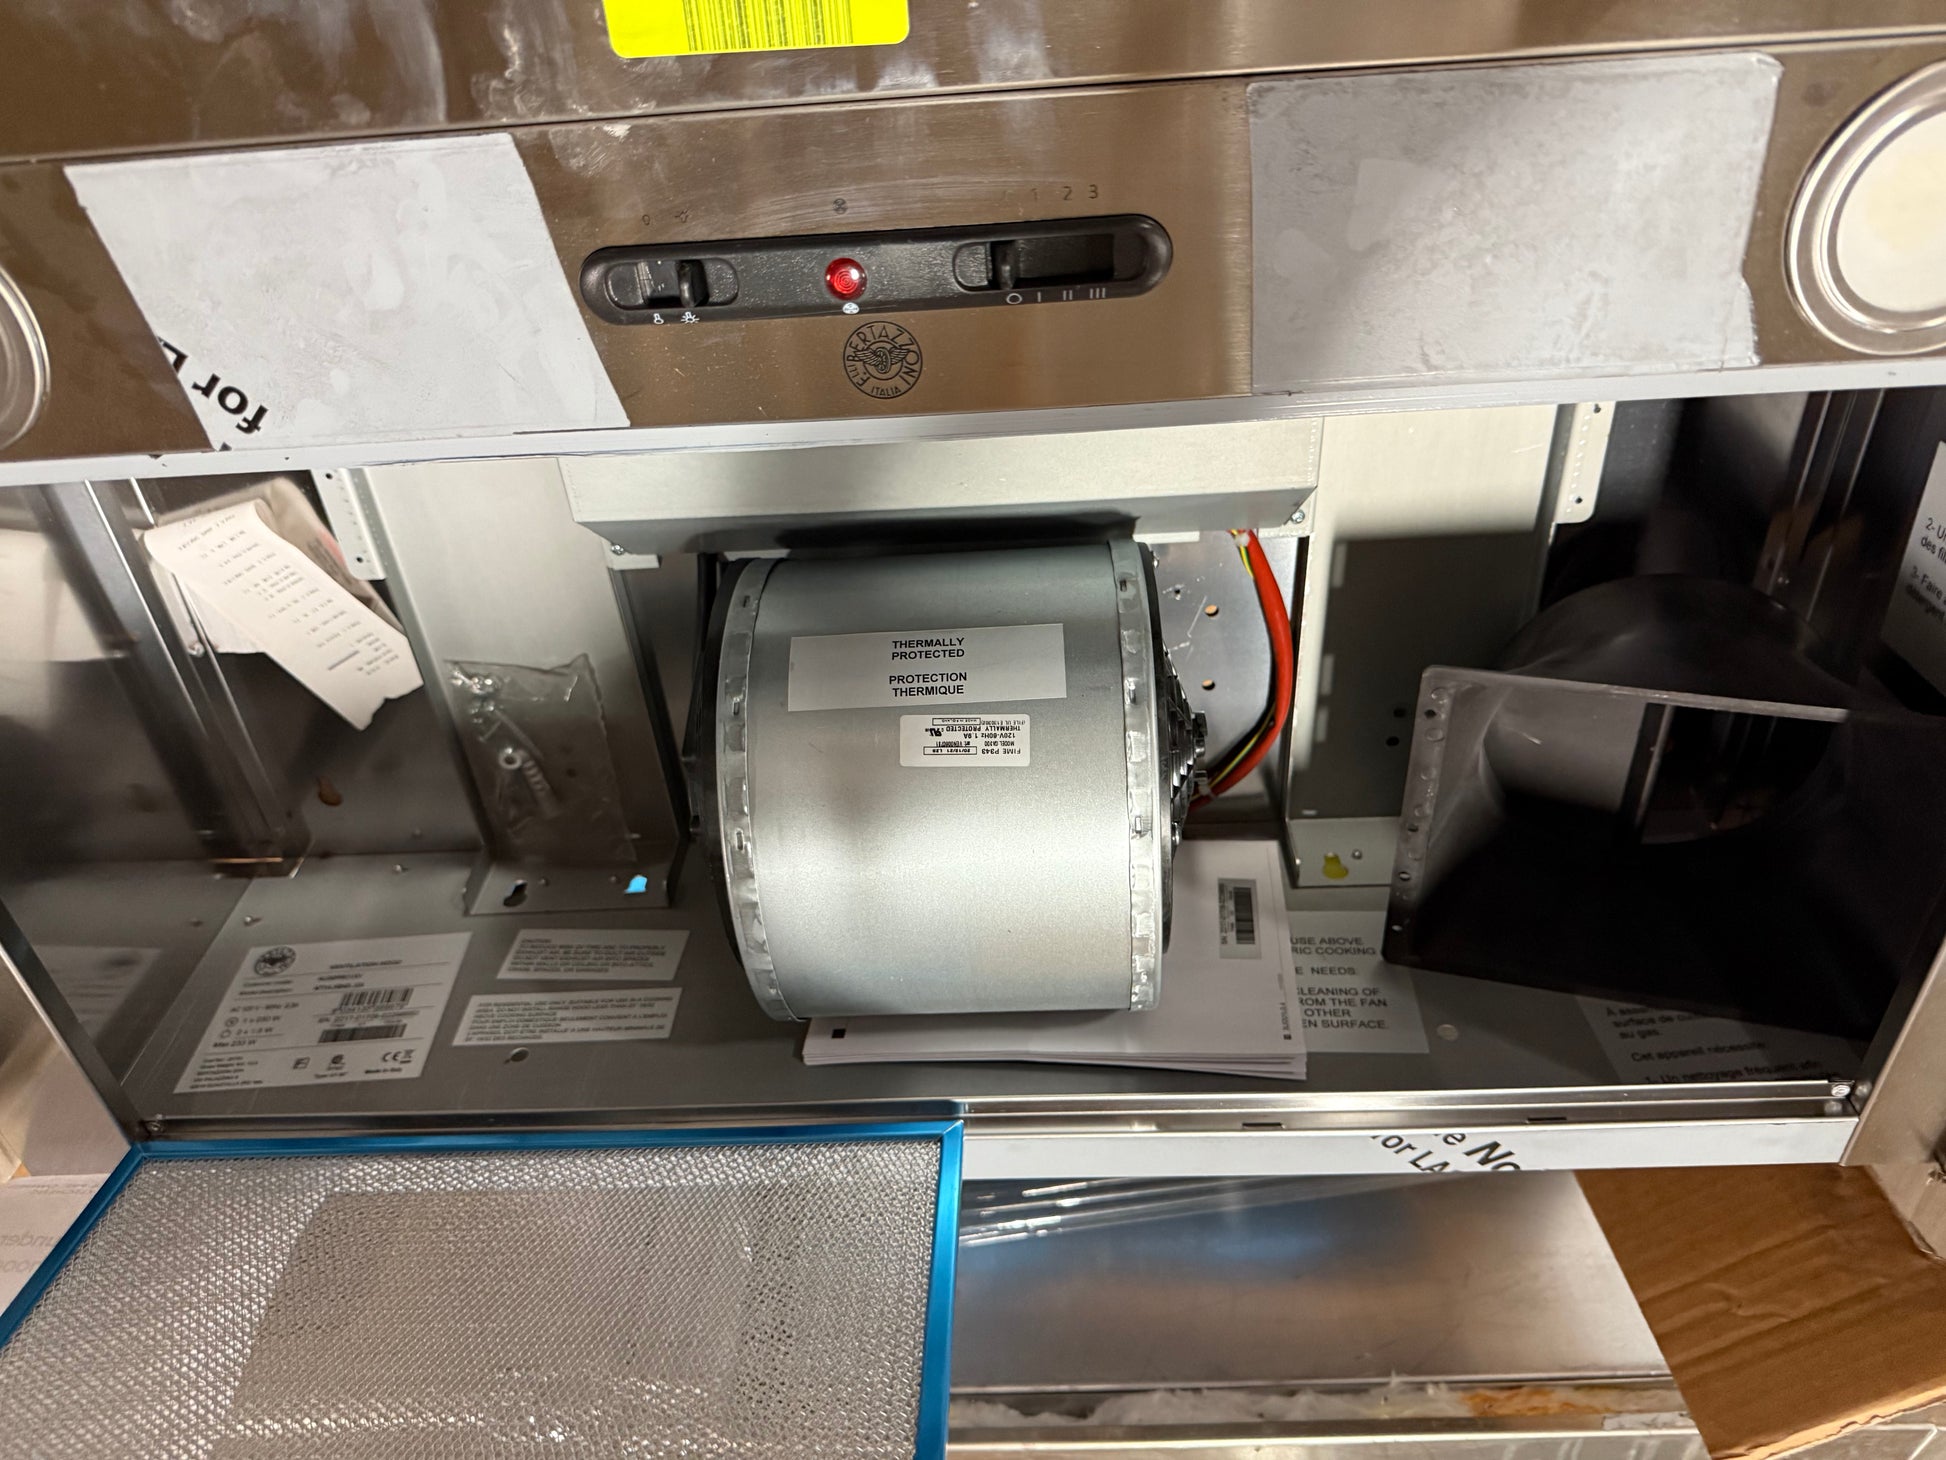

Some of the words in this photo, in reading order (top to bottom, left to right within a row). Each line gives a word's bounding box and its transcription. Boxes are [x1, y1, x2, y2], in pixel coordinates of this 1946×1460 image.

[1063, 185, 1073, 201] 2
[1087, 184, 1099, 200] 3
[846, 323, 920, 386] BERTAZZONI
[870, 385, 902, 397] ITALIA
[191, 372, 270, 435] for
[1921, 536, 1937, 555] des
[1920, 573, 1944, 600] Faire
[892, 637, 965, 649] THERMALLY
[891, 648, 965, 661] PROTECTED
[889, 672, 968, 685] PROTECTION
[892, 684, 965, 697] THERMIQUE
[1290, 936, 1317, 945] USE
[1319, 937, 1365, 946] ABOVE
[1315, 946, 1376, 956] COOKING
[1297, 986, 1359, 996] LEANING
[1361, 987, 1381, 996] OF
[1328, 998, 1357, 1007] THE
[1360, 998, 1388, 1007] FAN
[1304, 1008, 1352, 1018] OTHER
